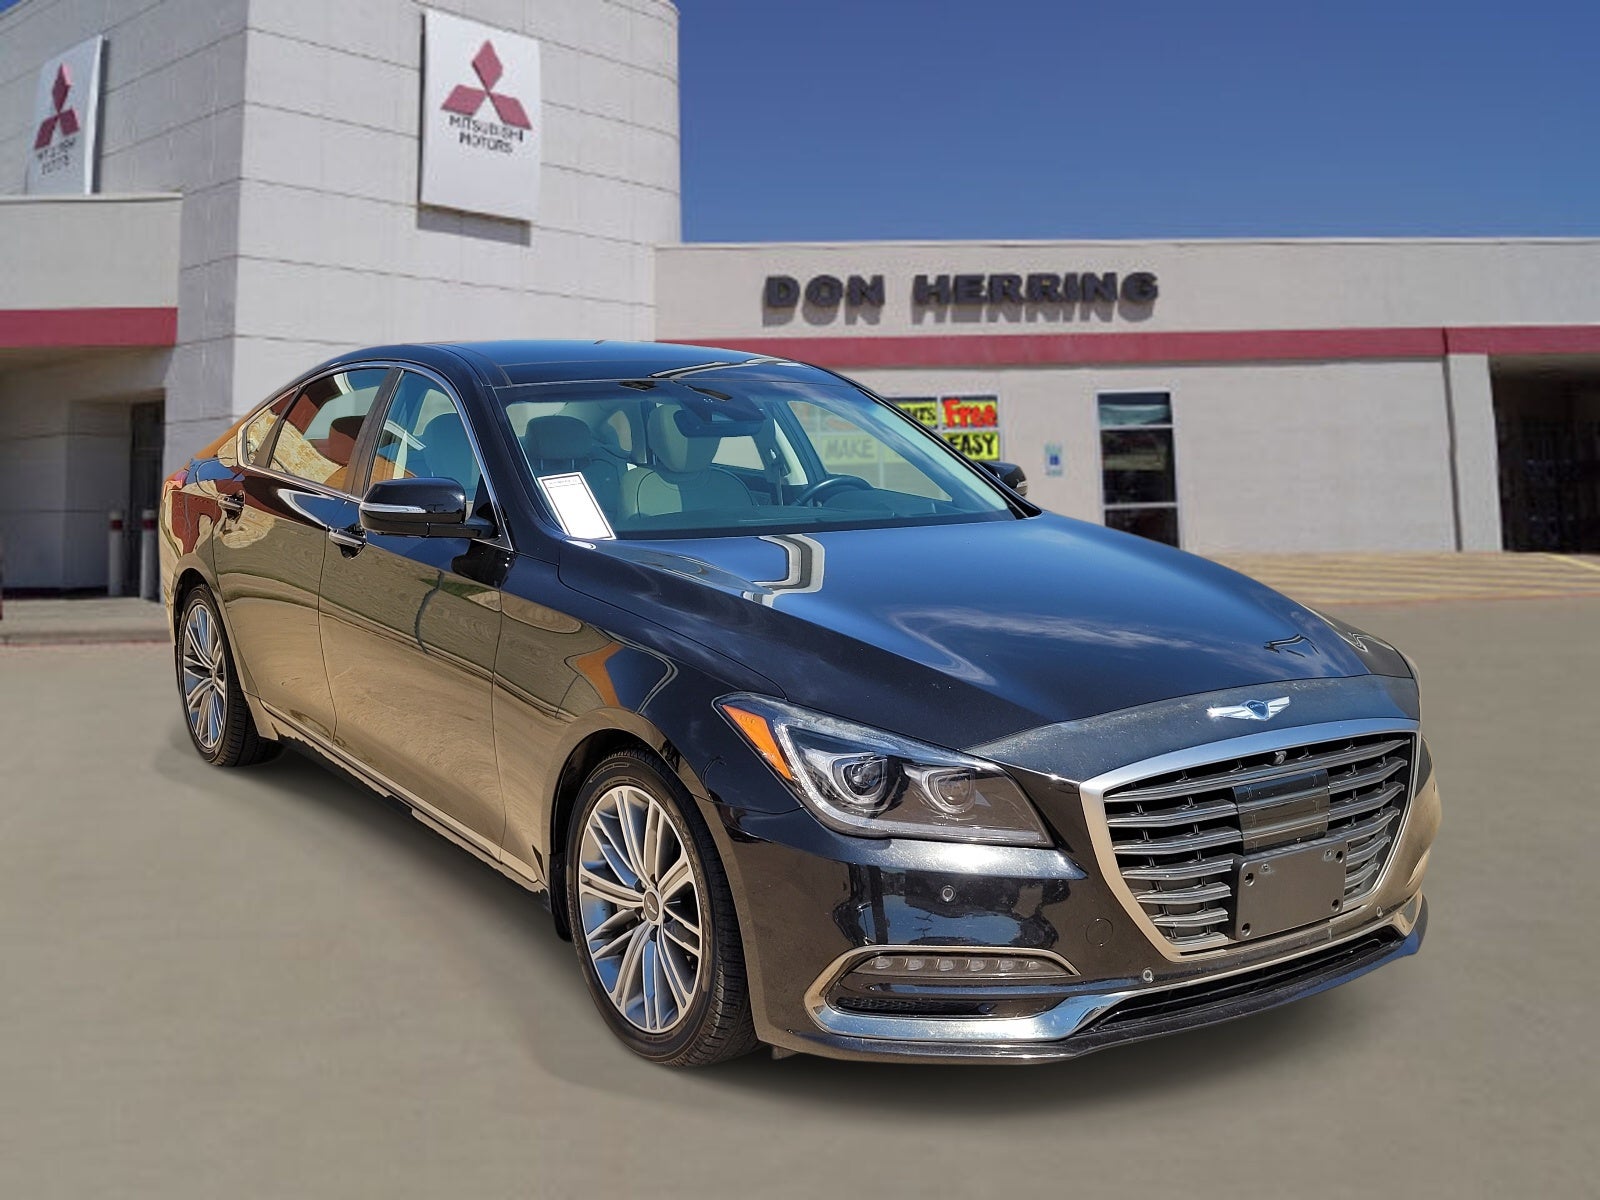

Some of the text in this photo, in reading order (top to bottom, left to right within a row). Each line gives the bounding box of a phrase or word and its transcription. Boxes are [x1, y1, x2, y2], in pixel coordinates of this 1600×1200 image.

[459, 132, 513, 154] MOTORS
[764, 272, 1159, 307] DON HERRING
[942, 399, 996, 428] Free
[824, 439, 875, 459] MAKE
